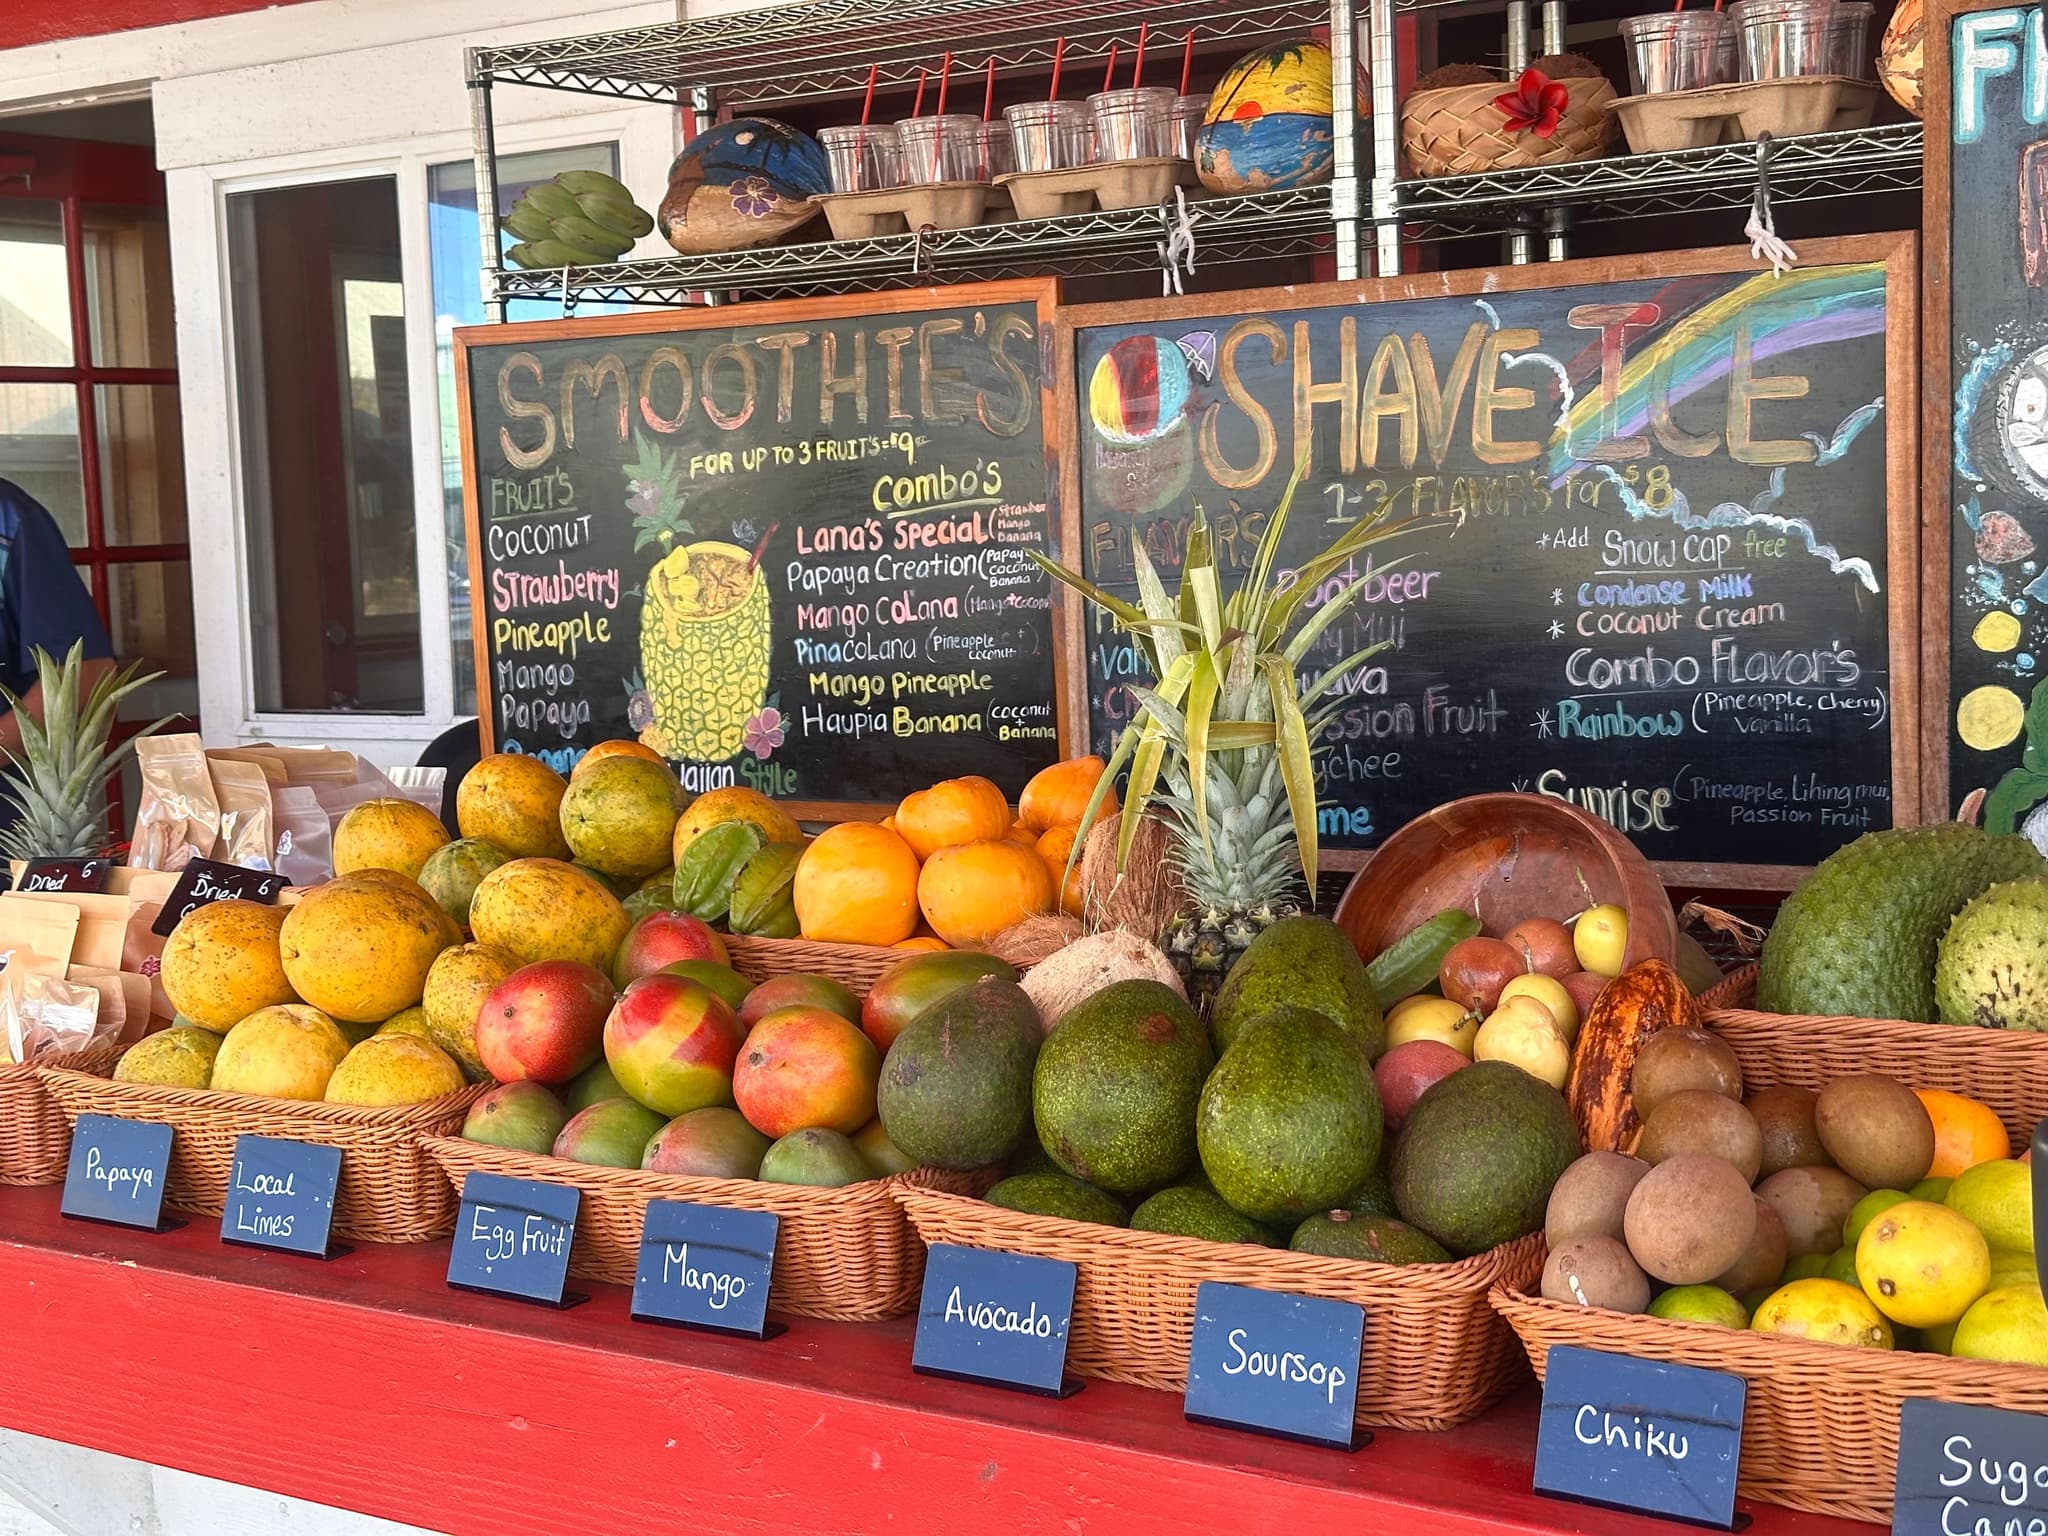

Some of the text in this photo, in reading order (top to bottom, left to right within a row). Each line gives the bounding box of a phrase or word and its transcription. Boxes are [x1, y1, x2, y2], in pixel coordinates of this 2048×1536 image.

[498, 311, 1034, 470] SMOOTHIE'S
[1200, 303, 1819, 489] SHAVE ICE
[689, 452, 734, 480] FOR
[742, 447, 768, 472] UP
[773, 446, 794, 465] TO
[798, 440, 812, 465] 3
[490, 466, 575, 513] FRUIT'S
[1624, 464, 1673, 512] $8
[797, 517, 883, 554] Lana's
[1089, 501, 1269, 579] FLAVR'S
[1553, 526, 1590, 550] Add
[1602, 529, 1676, 568] Snow
[1744, 529, 1788, 559] free
[787, 560, 869, 595] Papaya
[874, 552, 978, 583] Creation
[1365, 552, 1441, 605] beer
[494, 611, 612, 660] Pineapple
[797, 598, 869, 638] Mango
[1696, 602, 1786, 632] Cream
[496, 659, 576, 696] Mango
[809, 669, 993, 706] Mango Pineapple
[1295, 664, 1389, 696] uva
[1565, 646, 1700, 690] Combo
[501, 693, 591, 740] Papaya
[801, 702, 888, 739] Haupia
[892, 705, 982, 737] Banana
[998, 724, 1056, 741] Banana
[1326, 683, 1510, 742] sion Fruit
[1556, 699, 1684, 740] Rainbow
[1310, 743, 1402, 795] ychee
[1317, 805, 1375, 835] me
[1730, 804, 1872, 828] Passion Fruit
[81, 861, 97, 879] 6
[257, 879, 270, 896] 6
[86, 1147, 153, 1199] Papaya
[236, 1161, 296, 1196] Local
[237, 1204, 295, 1238] Limes
[471, 1204, 566, 1261] Egg Fruit
[663, 1242, 746, 1310] Mango
[944, 1285, 1051, 1339] Avocado
[1222, 1327, 1346, 1404] Soursop
[1573, 1404, 1689, 1460] Chiku
